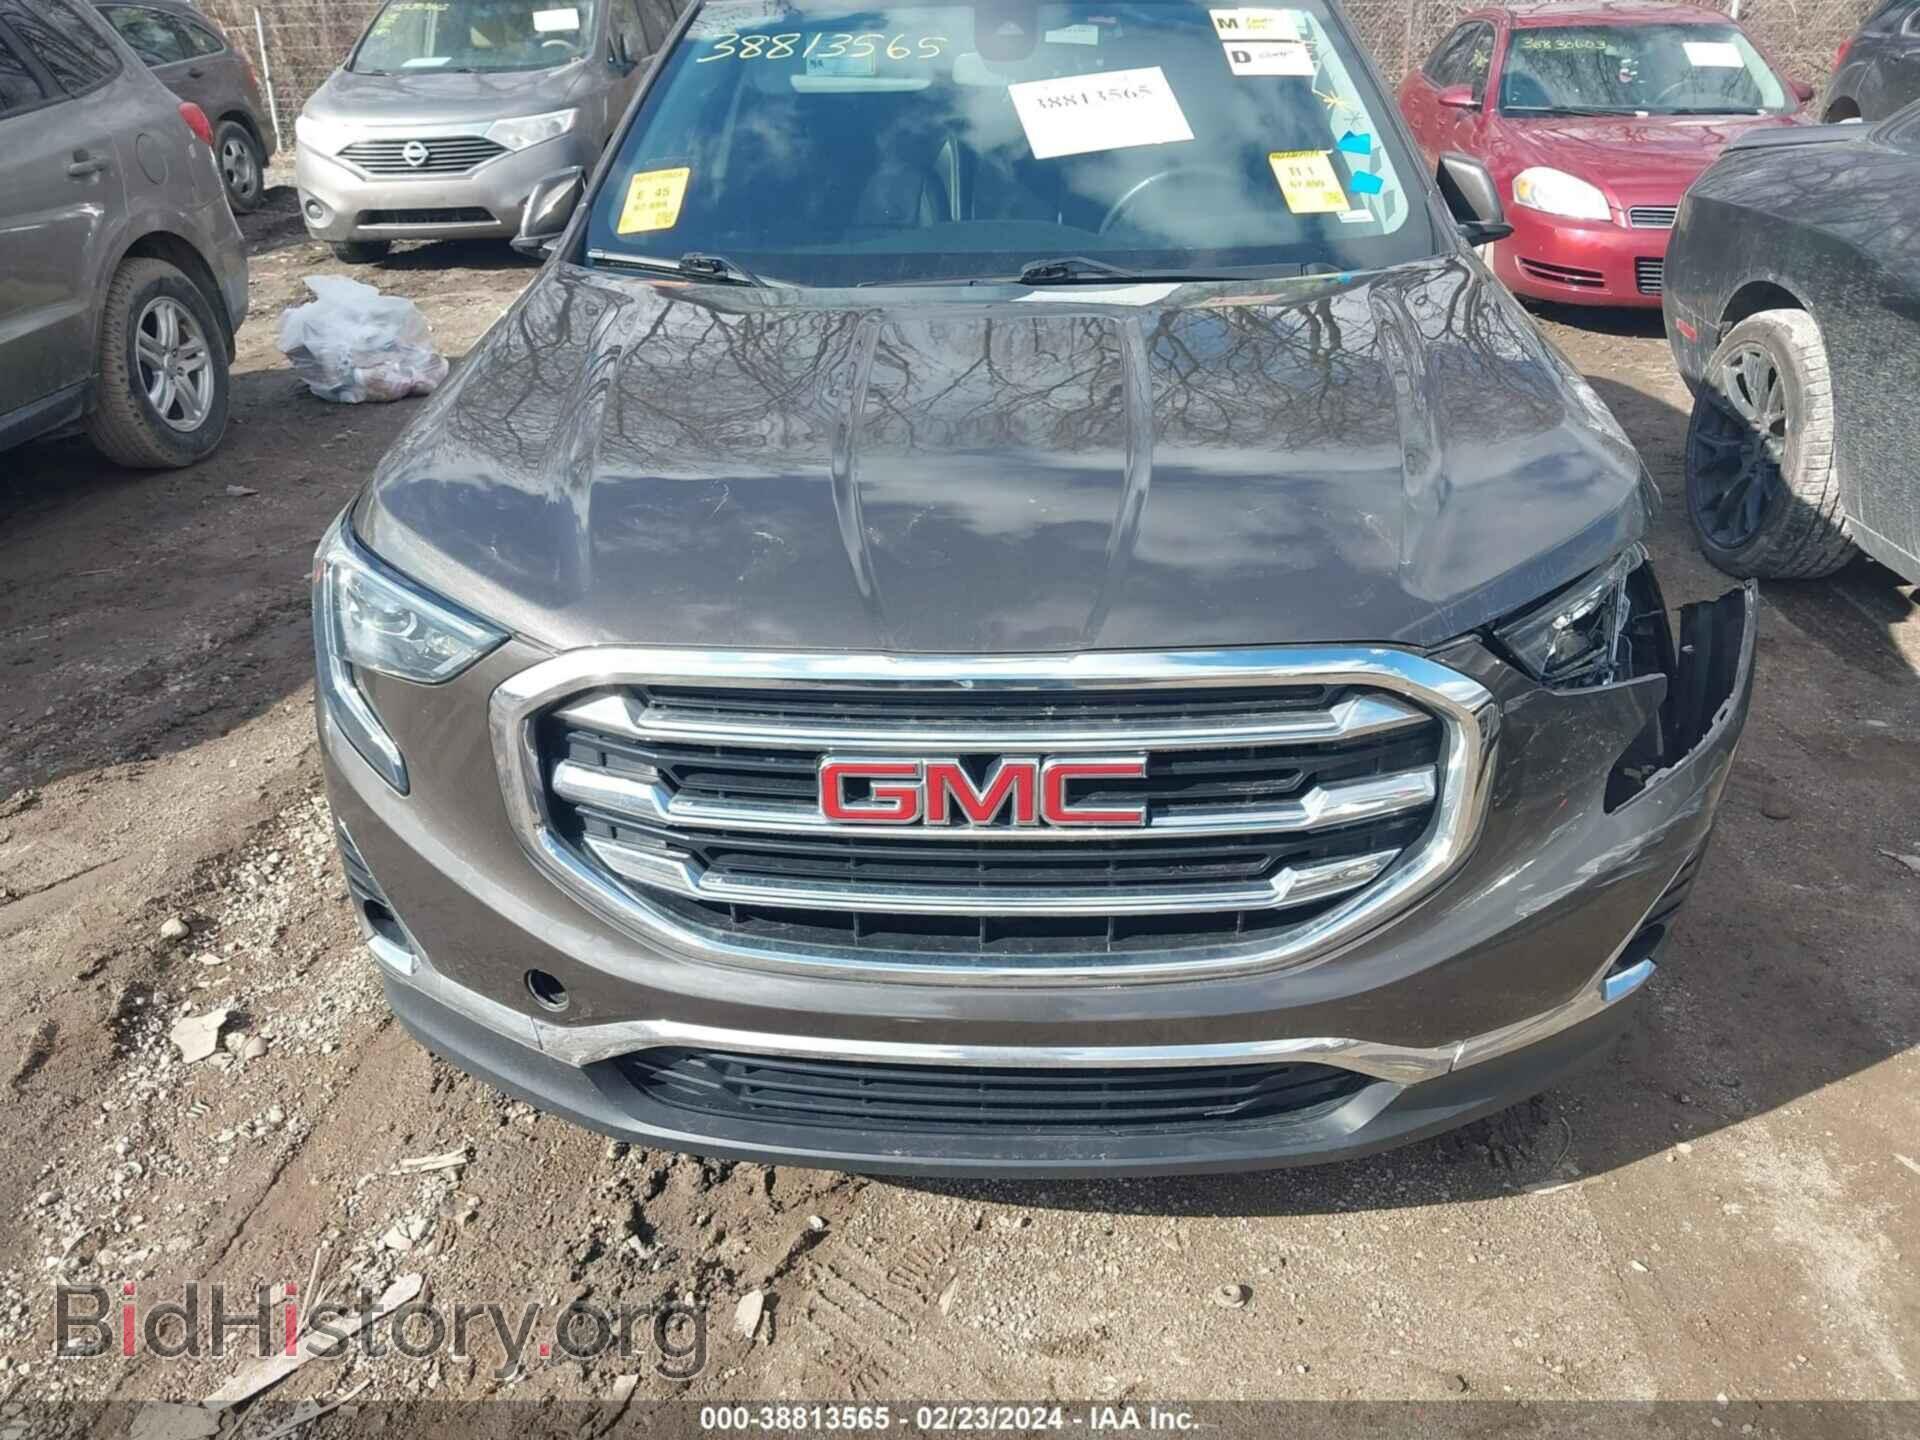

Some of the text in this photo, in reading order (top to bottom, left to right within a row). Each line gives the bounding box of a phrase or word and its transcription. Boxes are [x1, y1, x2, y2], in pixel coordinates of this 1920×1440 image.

[1216, 17, 1239, 29] M
[696, 33, 947, 62] 38813565
[1231, 50, 1252, 63] D
[1037, 84, 1153, 109] 38813565
[819, 755, 1147, 827] GMC
